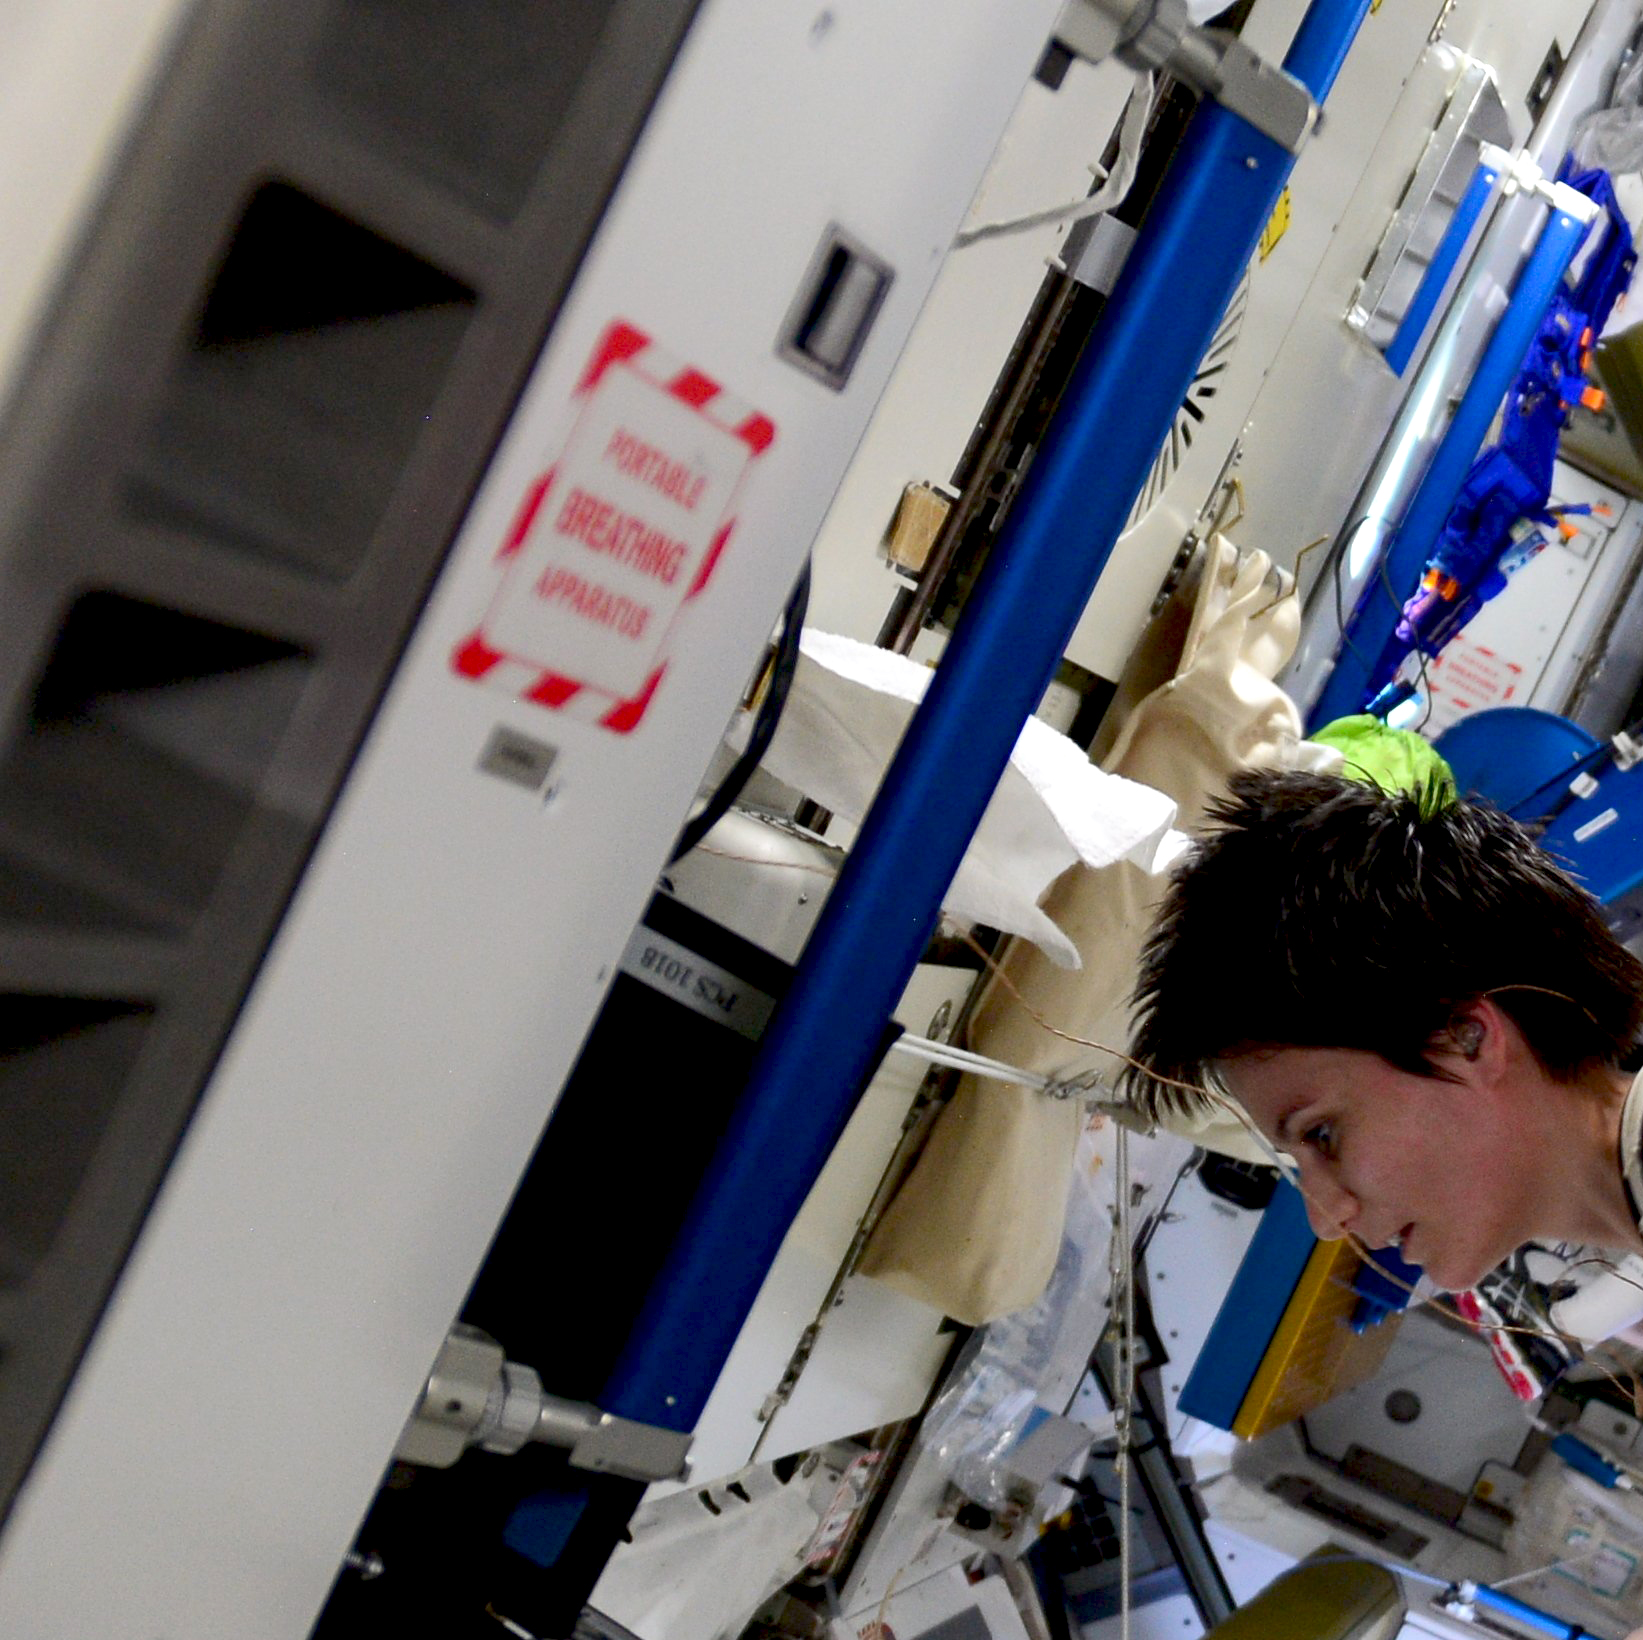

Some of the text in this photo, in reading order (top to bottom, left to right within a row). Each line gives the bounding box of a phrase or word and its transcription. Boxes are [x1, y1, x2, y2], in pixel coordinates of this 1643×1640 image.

[604, 429, 708, 512] PORTABLE
[555, 486, 690, 586] BREATHING
[535, 565, 653, 641] APPARATUS
